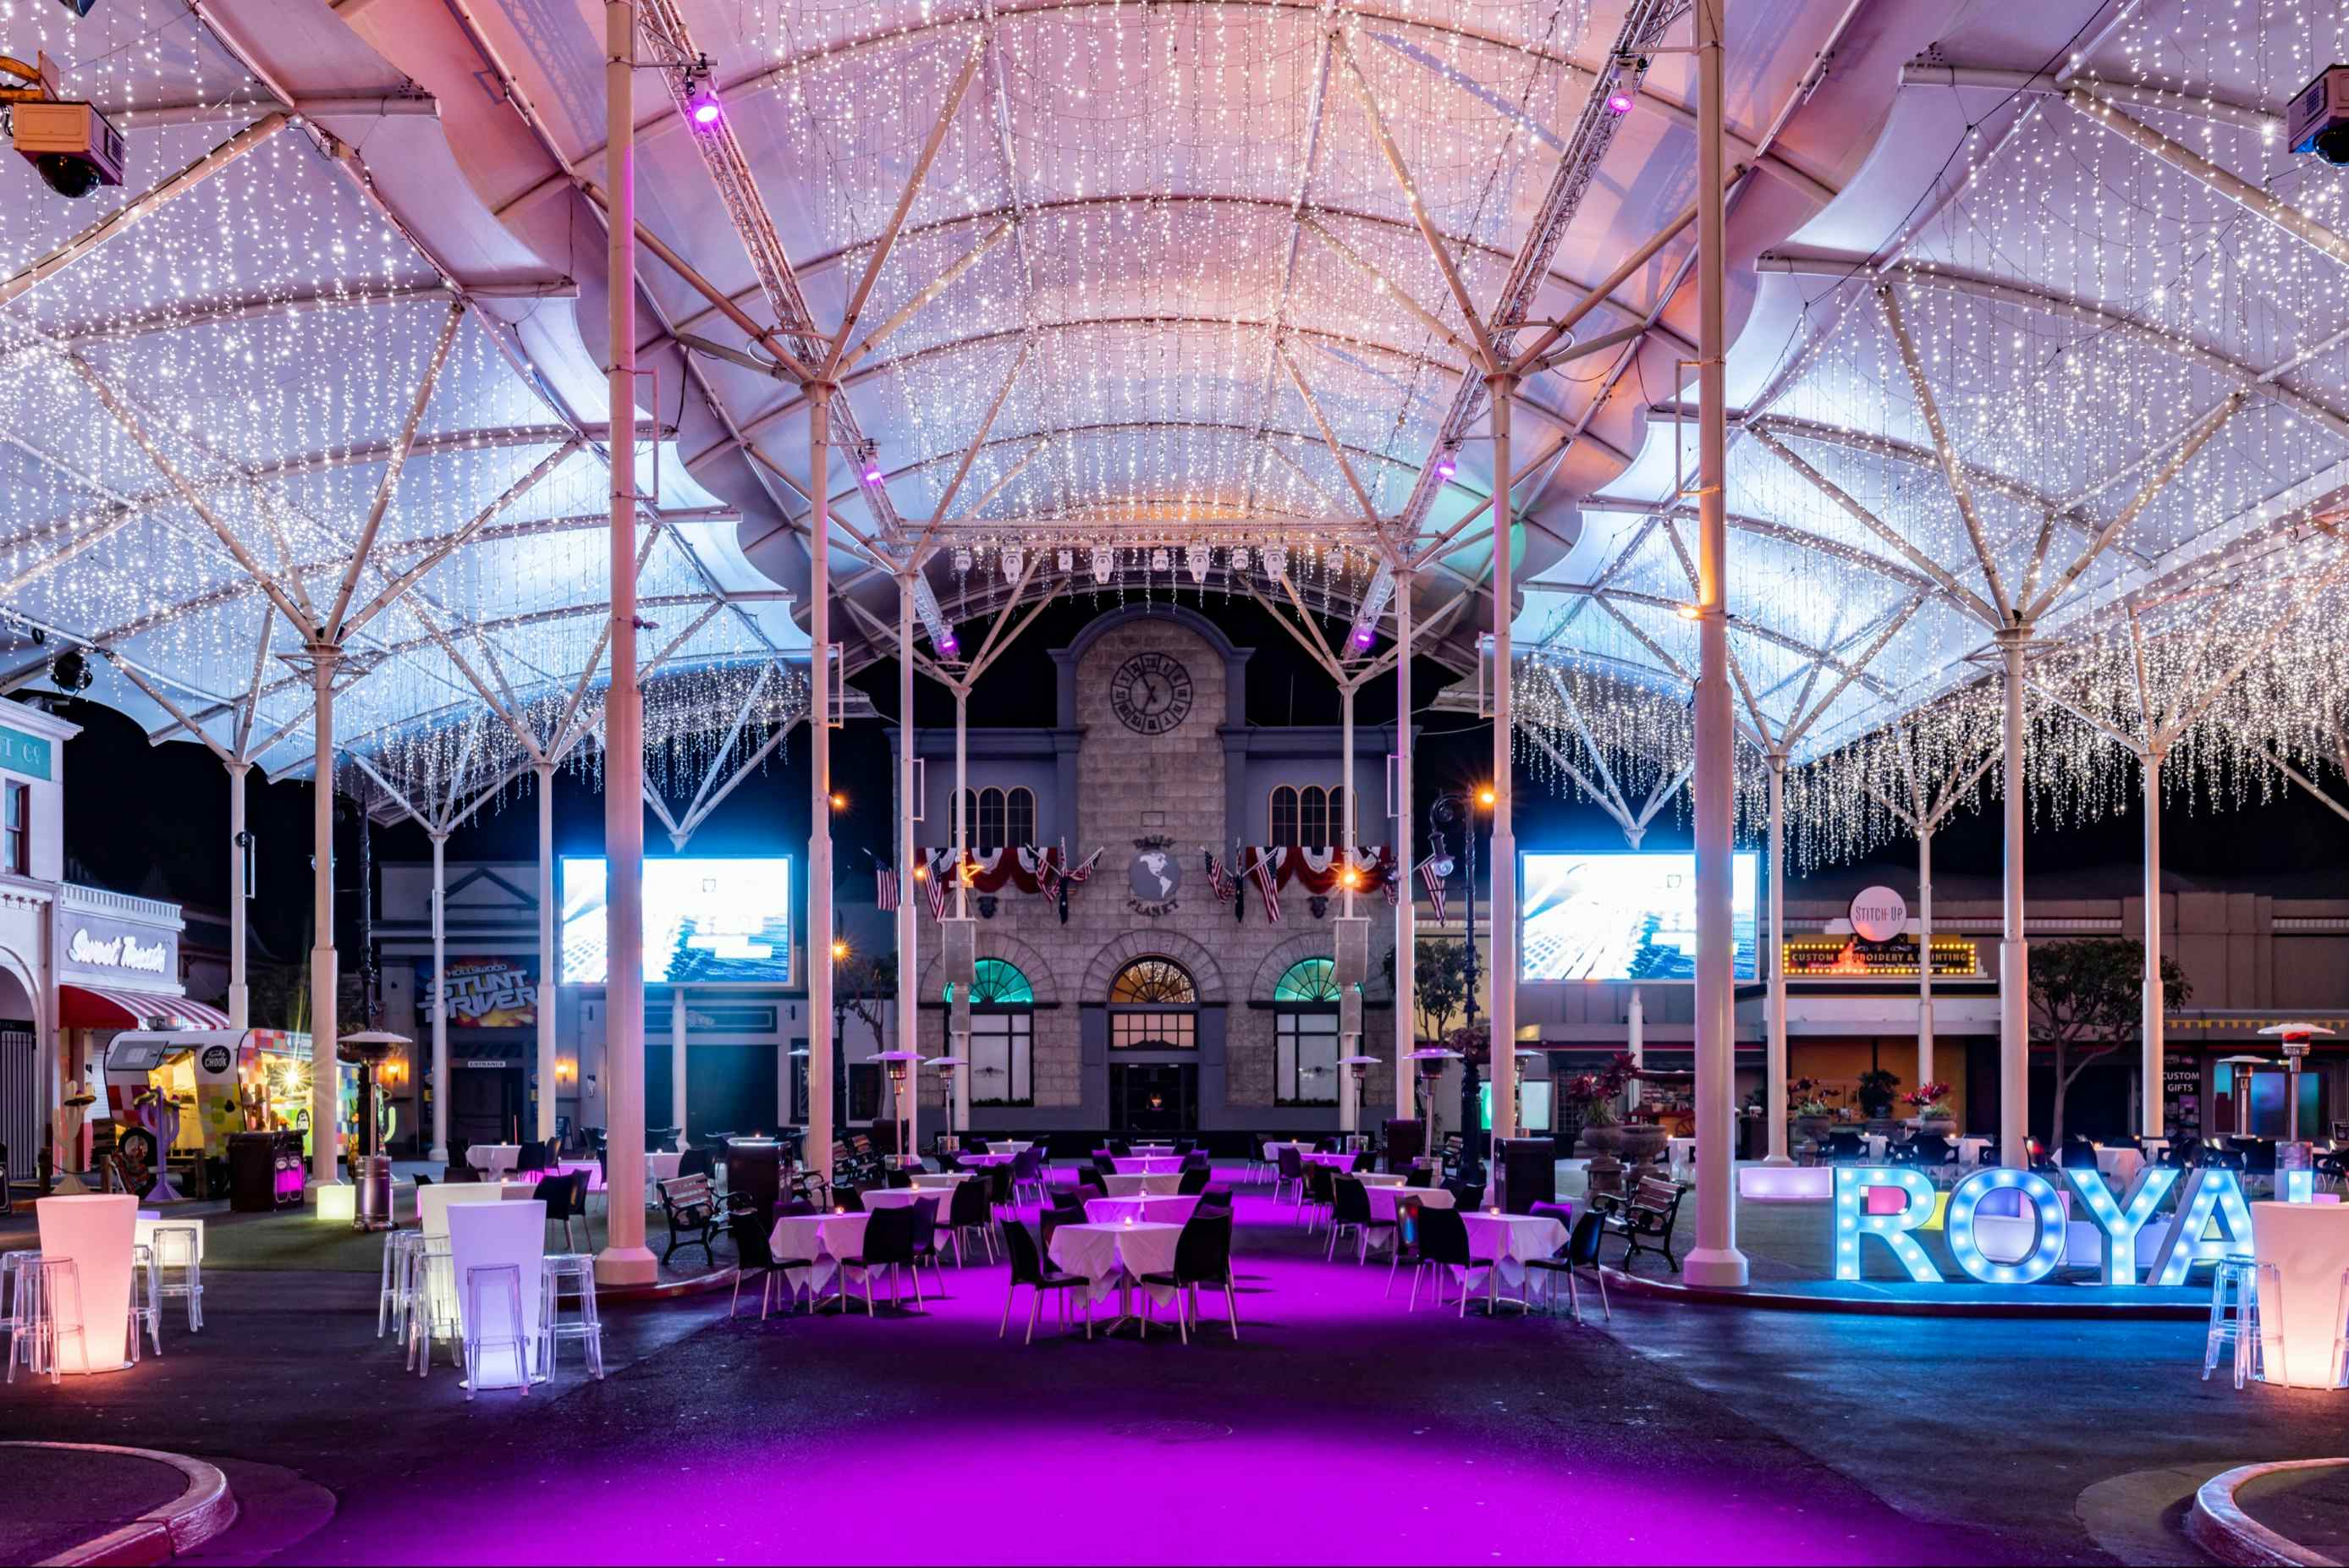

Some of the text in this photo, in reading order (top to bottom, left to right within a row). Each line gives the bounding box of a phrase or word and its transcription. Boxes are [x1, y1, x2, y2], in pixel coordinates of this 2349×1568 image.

[1856, 906, 1888, 921] STITCH
[1792, 953, 1835, 961] CUSTOM
[2167, 1083, 2193, 1092] GIFTS
